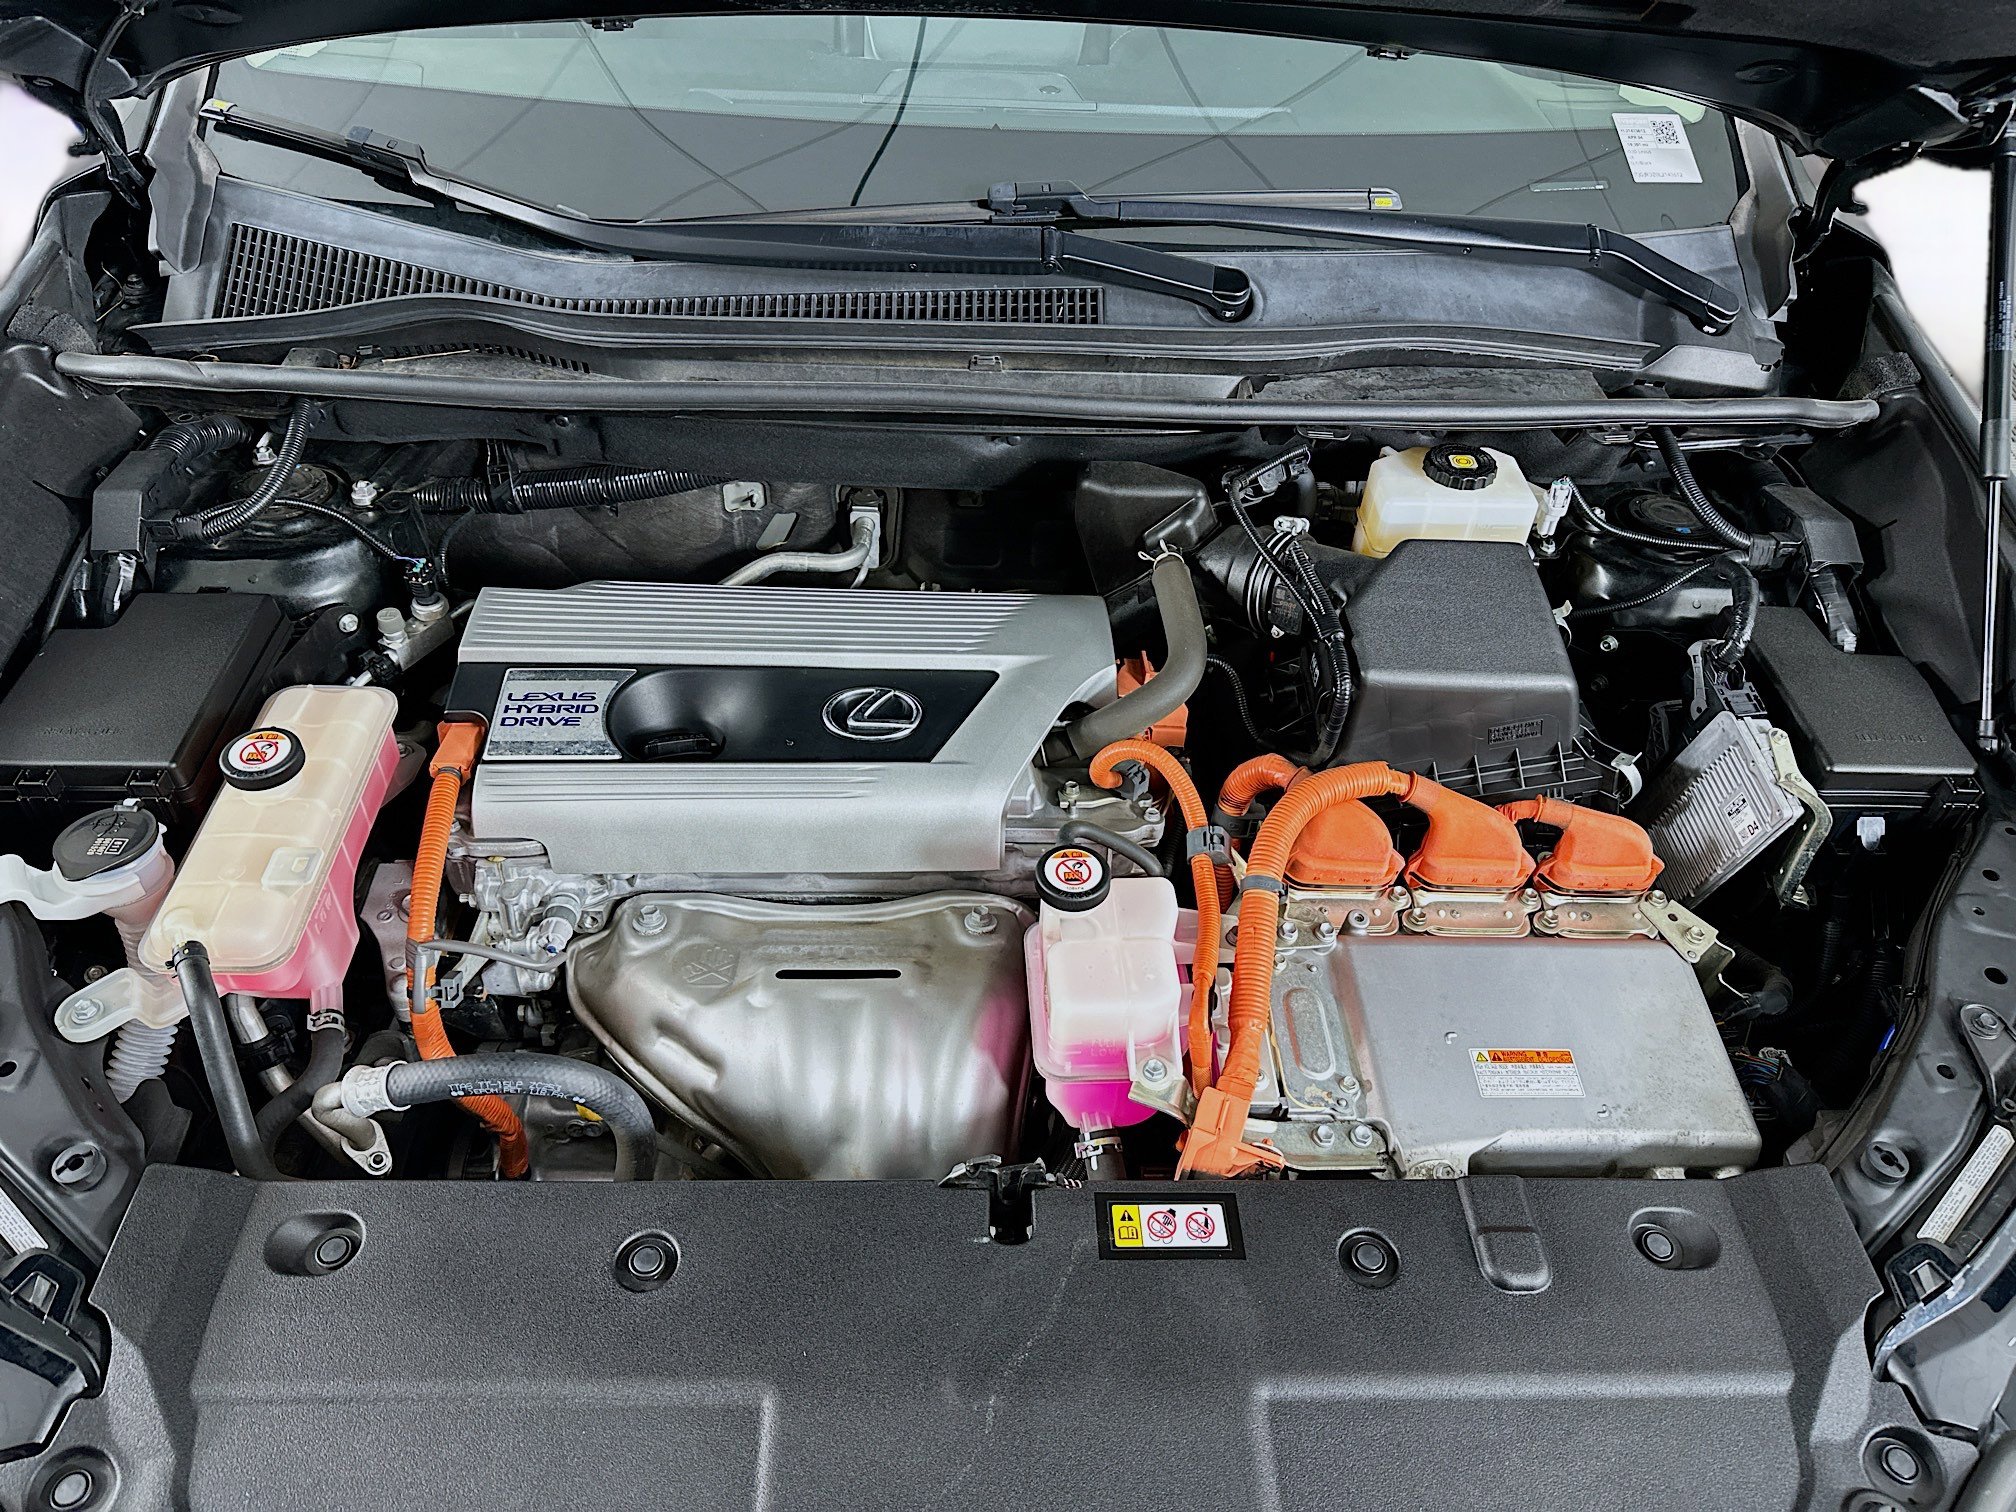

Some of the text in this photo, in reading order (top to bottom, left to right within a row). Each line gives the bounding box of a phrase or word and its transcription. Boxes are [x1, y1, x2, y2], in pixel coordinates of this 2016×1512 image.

[507, 691, 597, 702] LEXUS
[503, 704, 599, 714] HYBRID
[500, 716, 582, 727] DRIVE
